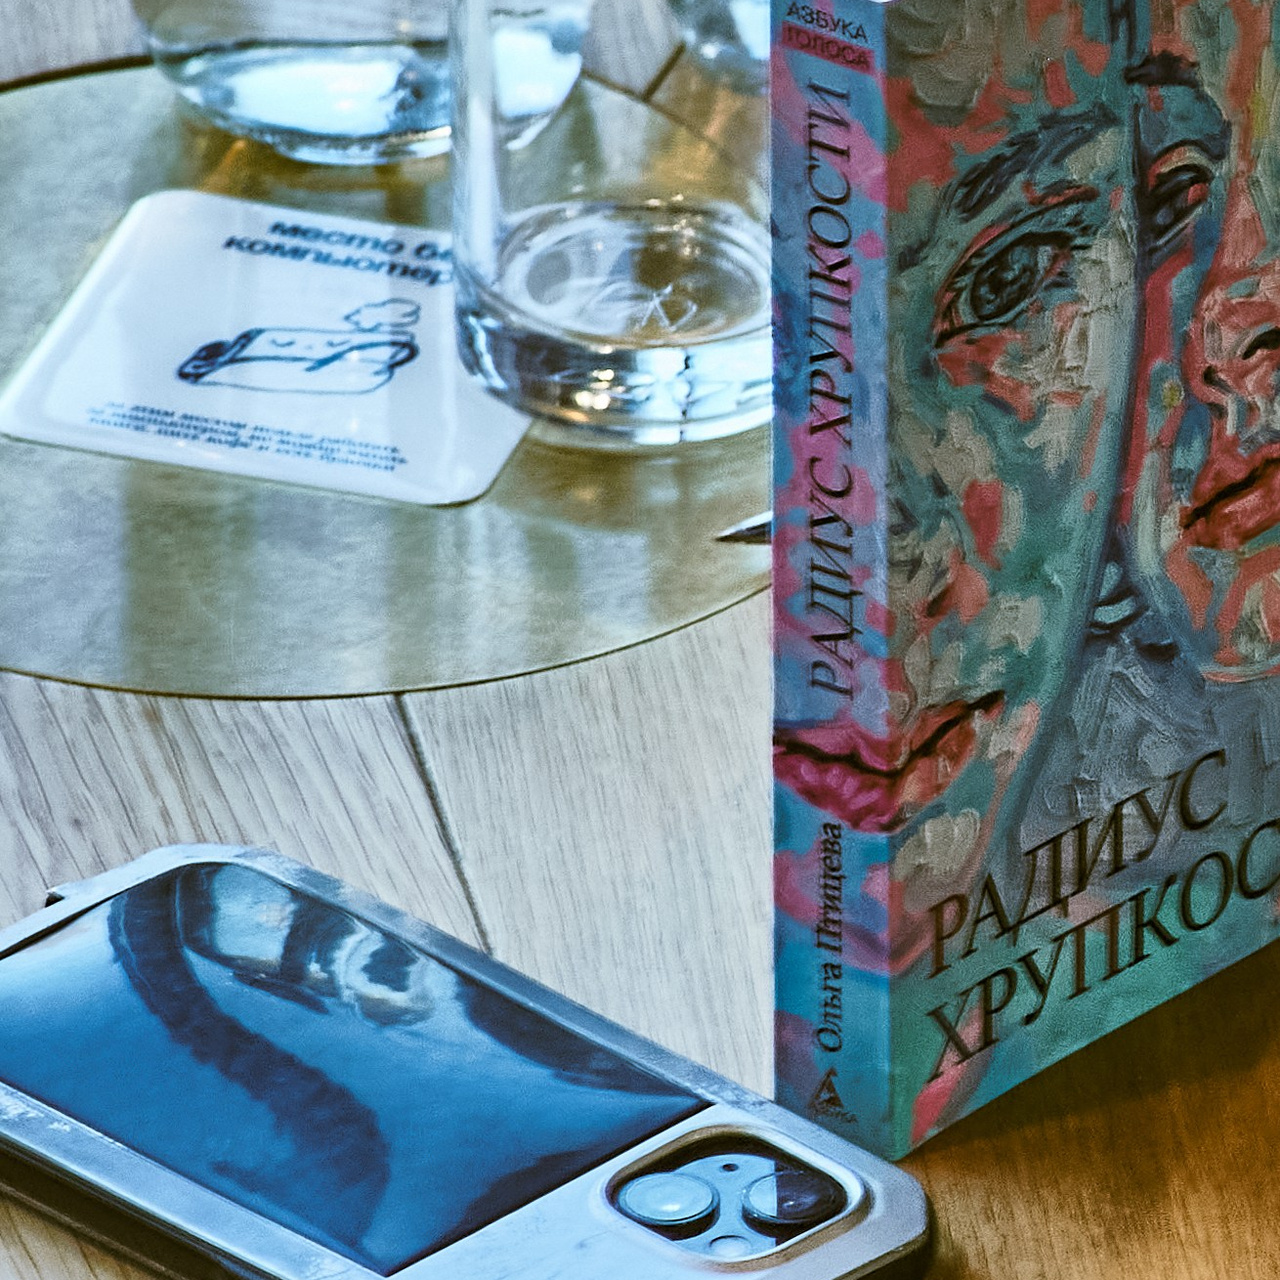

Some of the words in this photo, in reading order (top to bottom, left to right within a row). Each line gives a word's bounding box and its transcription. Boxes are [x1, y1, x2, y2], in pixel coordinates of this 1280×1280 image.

[786, 1, 868, 43] АЗБУКА
[808, 78, 853, 449] ХРУПКОСТИ
[808, 457, 863, 700] РАДИУС
[816, 821, 847, 955] Птицева
[927, 748, 1227, 980] РАДИУС
[816, 961, 843, 1053] Ольга
